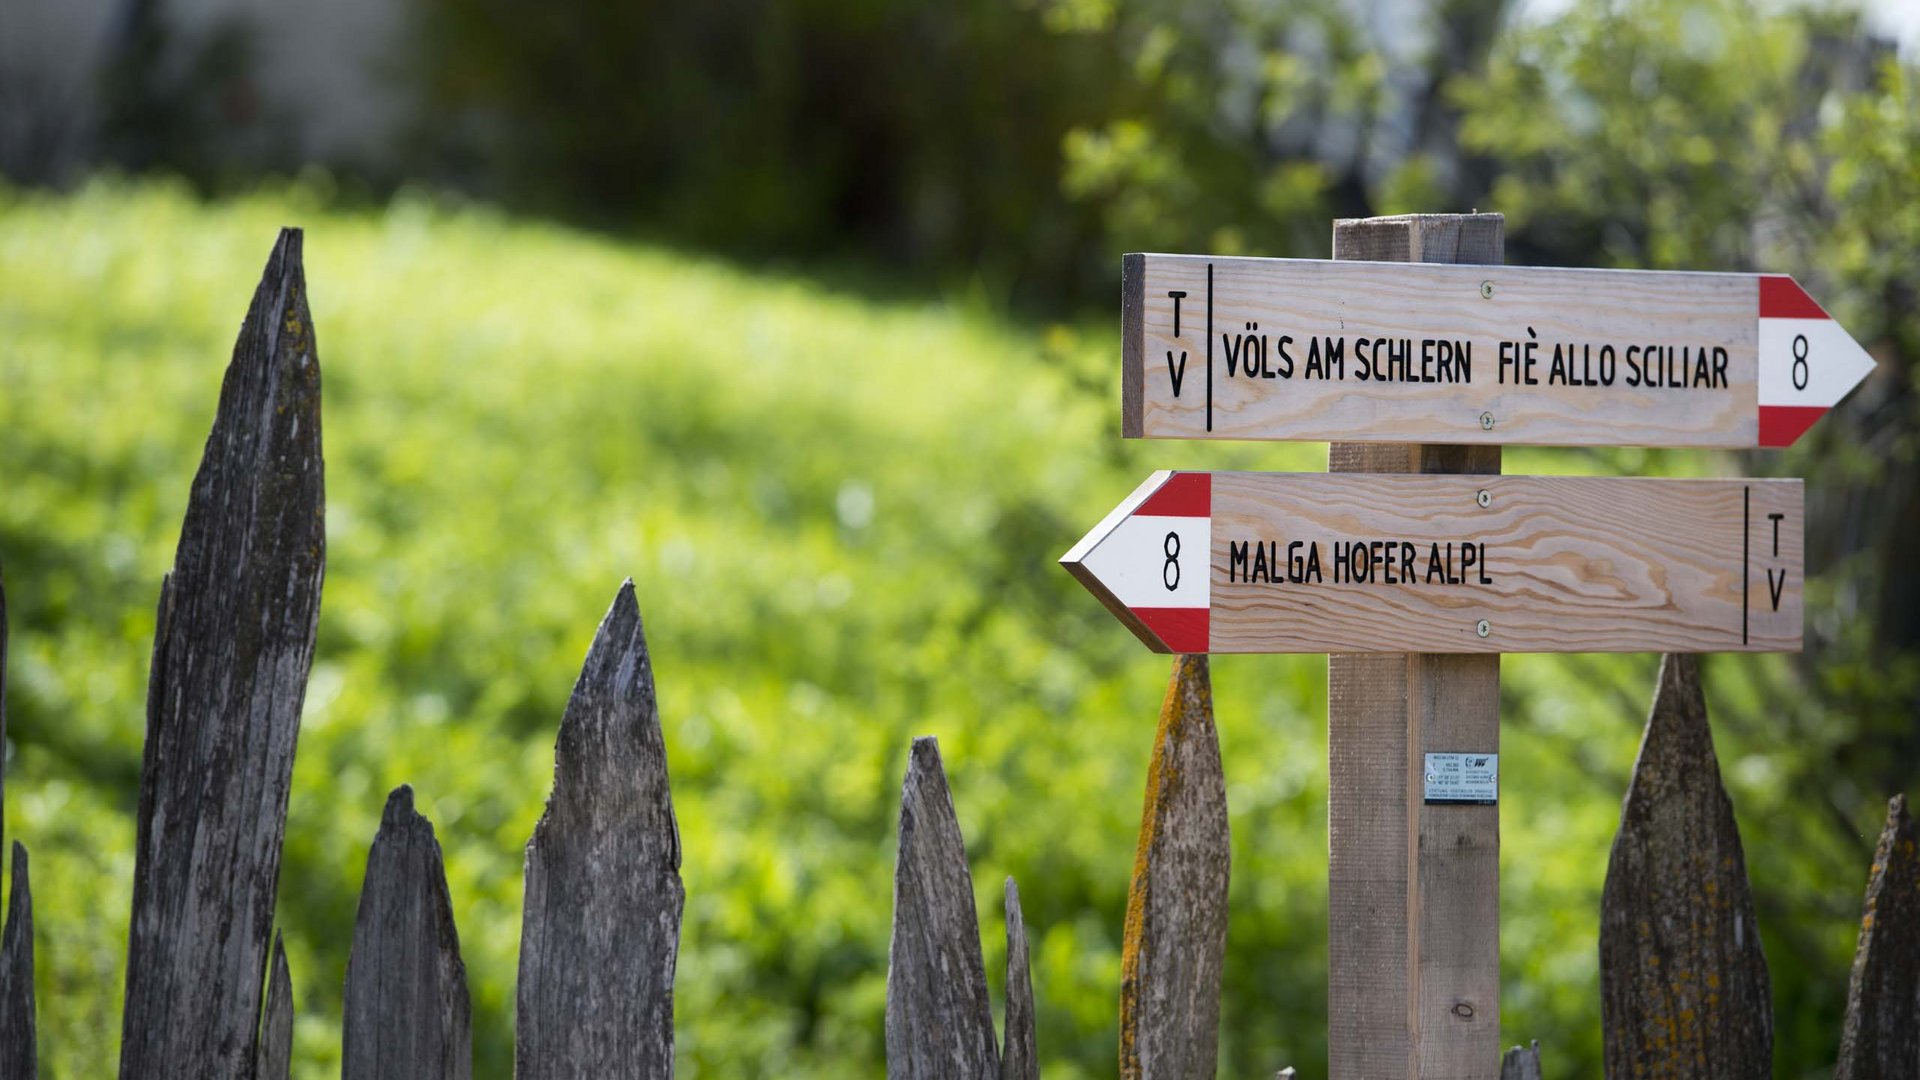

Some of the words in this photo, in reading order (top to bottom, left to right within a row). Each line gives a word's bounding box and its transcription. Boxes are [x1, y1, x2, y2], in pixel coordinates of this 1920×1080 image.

[1167, 290, 1187, 338] T
[1166, 350, 1188, 398] V
[1222, 321, 1295, 380] VÖLS
[1304, 336, 1345, 381] AM
[1354, 337, 1472, 384] SCHLERN
[1498, 326, 1539, 386] FIÈ
[1548, 343, 1616, 387] ALLO
[1625, 345, 1729, 389] SCILIAR
[1792, 335, 1808, 391] 8
[1767, 513, 1785, 558] T
[1163, 531, 1181, 592] 8
[1229, 540, 1323, 585] MALGA
[1333, 541, 1417, 585] HOFER
[1424, 542, 1493, 585] ALPL
[1767, 567, 1786, 613] V
